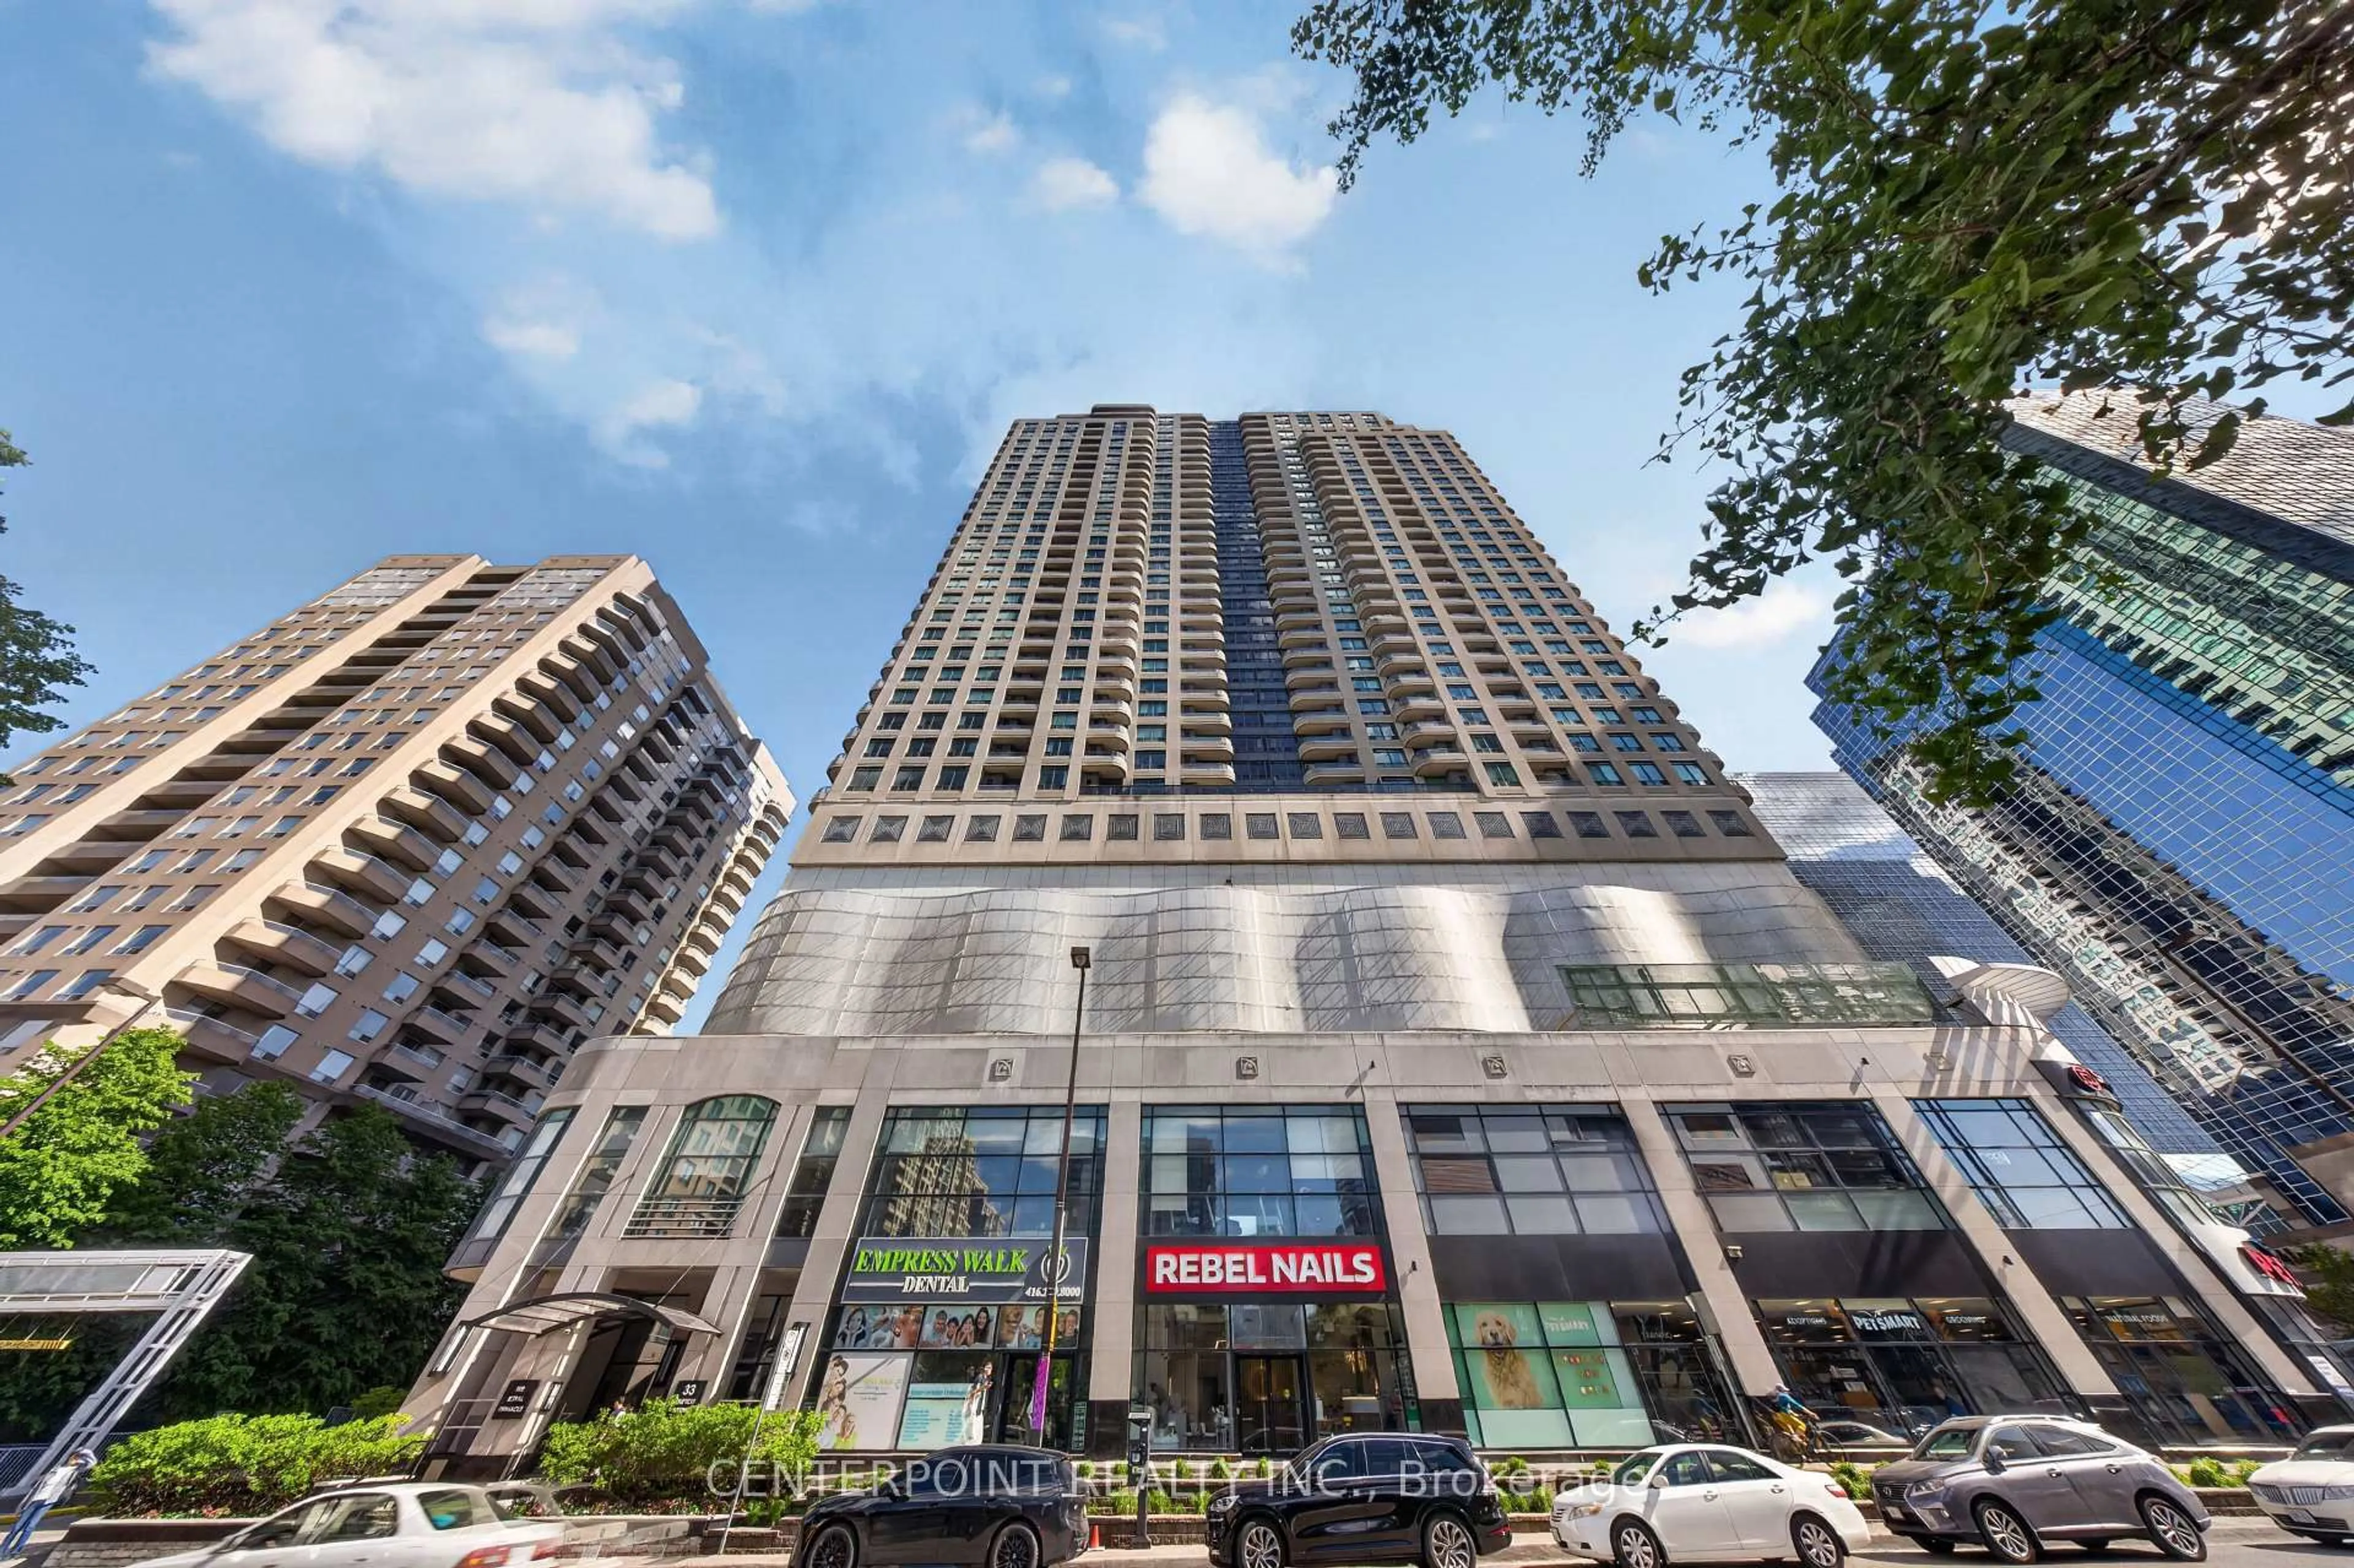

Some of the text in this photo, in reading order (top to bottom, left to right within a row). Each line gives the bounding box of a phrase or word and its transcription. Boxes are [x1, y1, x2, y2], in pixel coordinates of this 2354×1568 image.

[854, 1248, 1030, 1273] EMPRESS WALK
[1155, 1252, 1376, 1284] REBEL NAILS
[902, 1276, 970, 1293] DENTAL
[1851, 1314, 1921, 1331] PETSMART
[682, 1383, 696, 1396] 33
